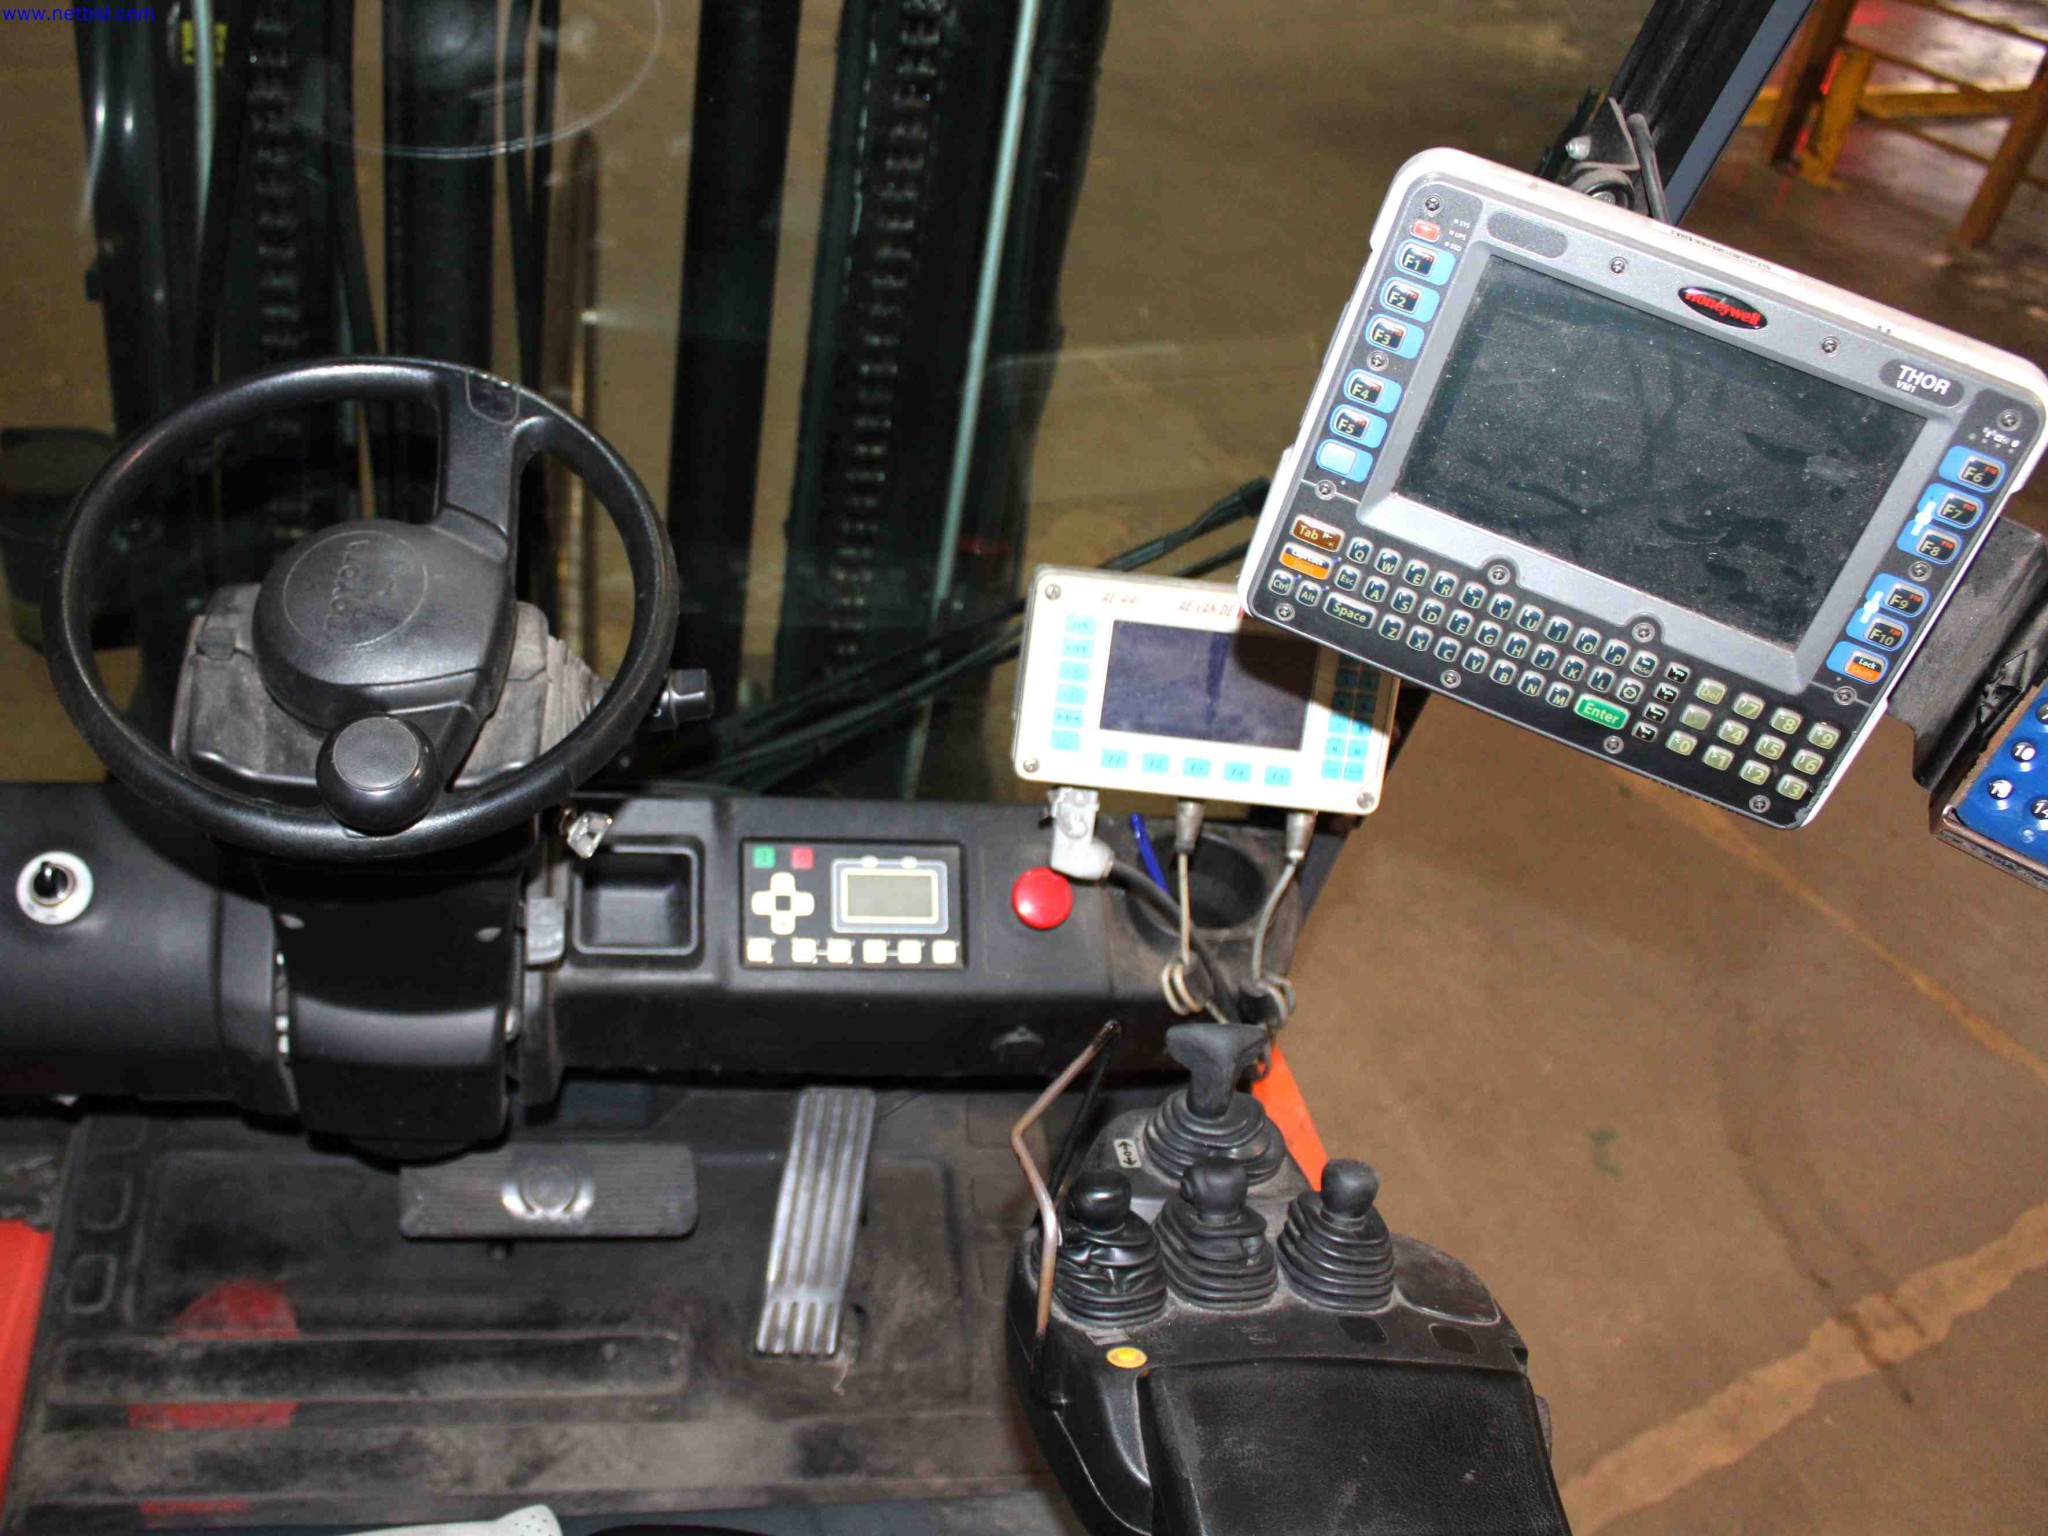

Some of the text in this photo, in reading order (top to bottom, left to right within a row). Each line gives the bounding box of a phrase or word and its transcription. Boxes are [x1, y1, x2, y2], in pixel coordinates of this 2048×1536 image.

[1403, 253, 1420, 271] F1
[1388, 290, 1407, 308] F2
[1373, 328, 1391, 345] F3
[1898, 364, 1952, 396] THOR
[1351, 383, 1370, 400] F4
[1896, 380, 1916, 393] VM1
[1337, 418, 1355, 434] F5
[1963, 466, 1984, 483] F6
[1942, 504, 1964, 519] F7
[1299, 525, 1319, 540] Tab
[1920, 540, 1941, 557] F8
[1355, 550, 1365, 561] Q
[1382, 561, 1394, 573] W
[1273, 579, 1290, 591] Ctrl
[1341, 575, 1355, 586] Esc
[1413, 574, 1422, 584] E
[1370, 589, 1380, 600] A
[1441, 585, 1451, 595] R
[1301, 592, 1316, 603] Alt
[1471, 596, 1480, 606] T
[1889, 594, 1909, 609] F9
[1400, 601, 1410, 611] S
[1333, 602, 1367, 623] Space
[1426, 612, 1437, 622] D
[1500, 607, 1509, 618] Y
[1456, 624, 1466, 633] F
[1527, 620, 1537, 630] U
[1387, 627, 1397, 638] Z
[1556, 631, 1563, 641] I
[1868, 628, 1894, 646] F10
[1415, 638, 1425, 649] X
[1483, 634, 1494, 644] G
[1511, 645, 1523, 656] H
[1582, 642, 1593, 652] O
[1443, 649, 1453, 660] C
[1612, 654, 1622, 664] P
[1472, 661, 1481, 670] V
[1540, 658, 1550, 667] J
[1858, 658, 1877, 669] Lock
[1499, 672, 1509, 682] B
[1568, 668, 1579, 679] K
[1526, 683, 1537, 694] N
[1597, 680, 1605, 690] L
[1553, 694, 1566, 706] M
[1700, 688, 1720, 702] Del
[1583, 702, 1619, 724] Enter
[1746, 703, 1759, 715] 7
[1782, 718, 1796, 732] 8
[1731, 730, 1743, 743] 4
[1821, 733, 1833, 746] 9
[1680, 740, 1691, 753] 0
[1767, 743, 1781, 756] 5
[1718, 755, 1728, 768] 1
[1805, 759, 1818, 772] 6
[1752, 770, 1765, 783] 2
[1789, 784, 1801, 797] 3
